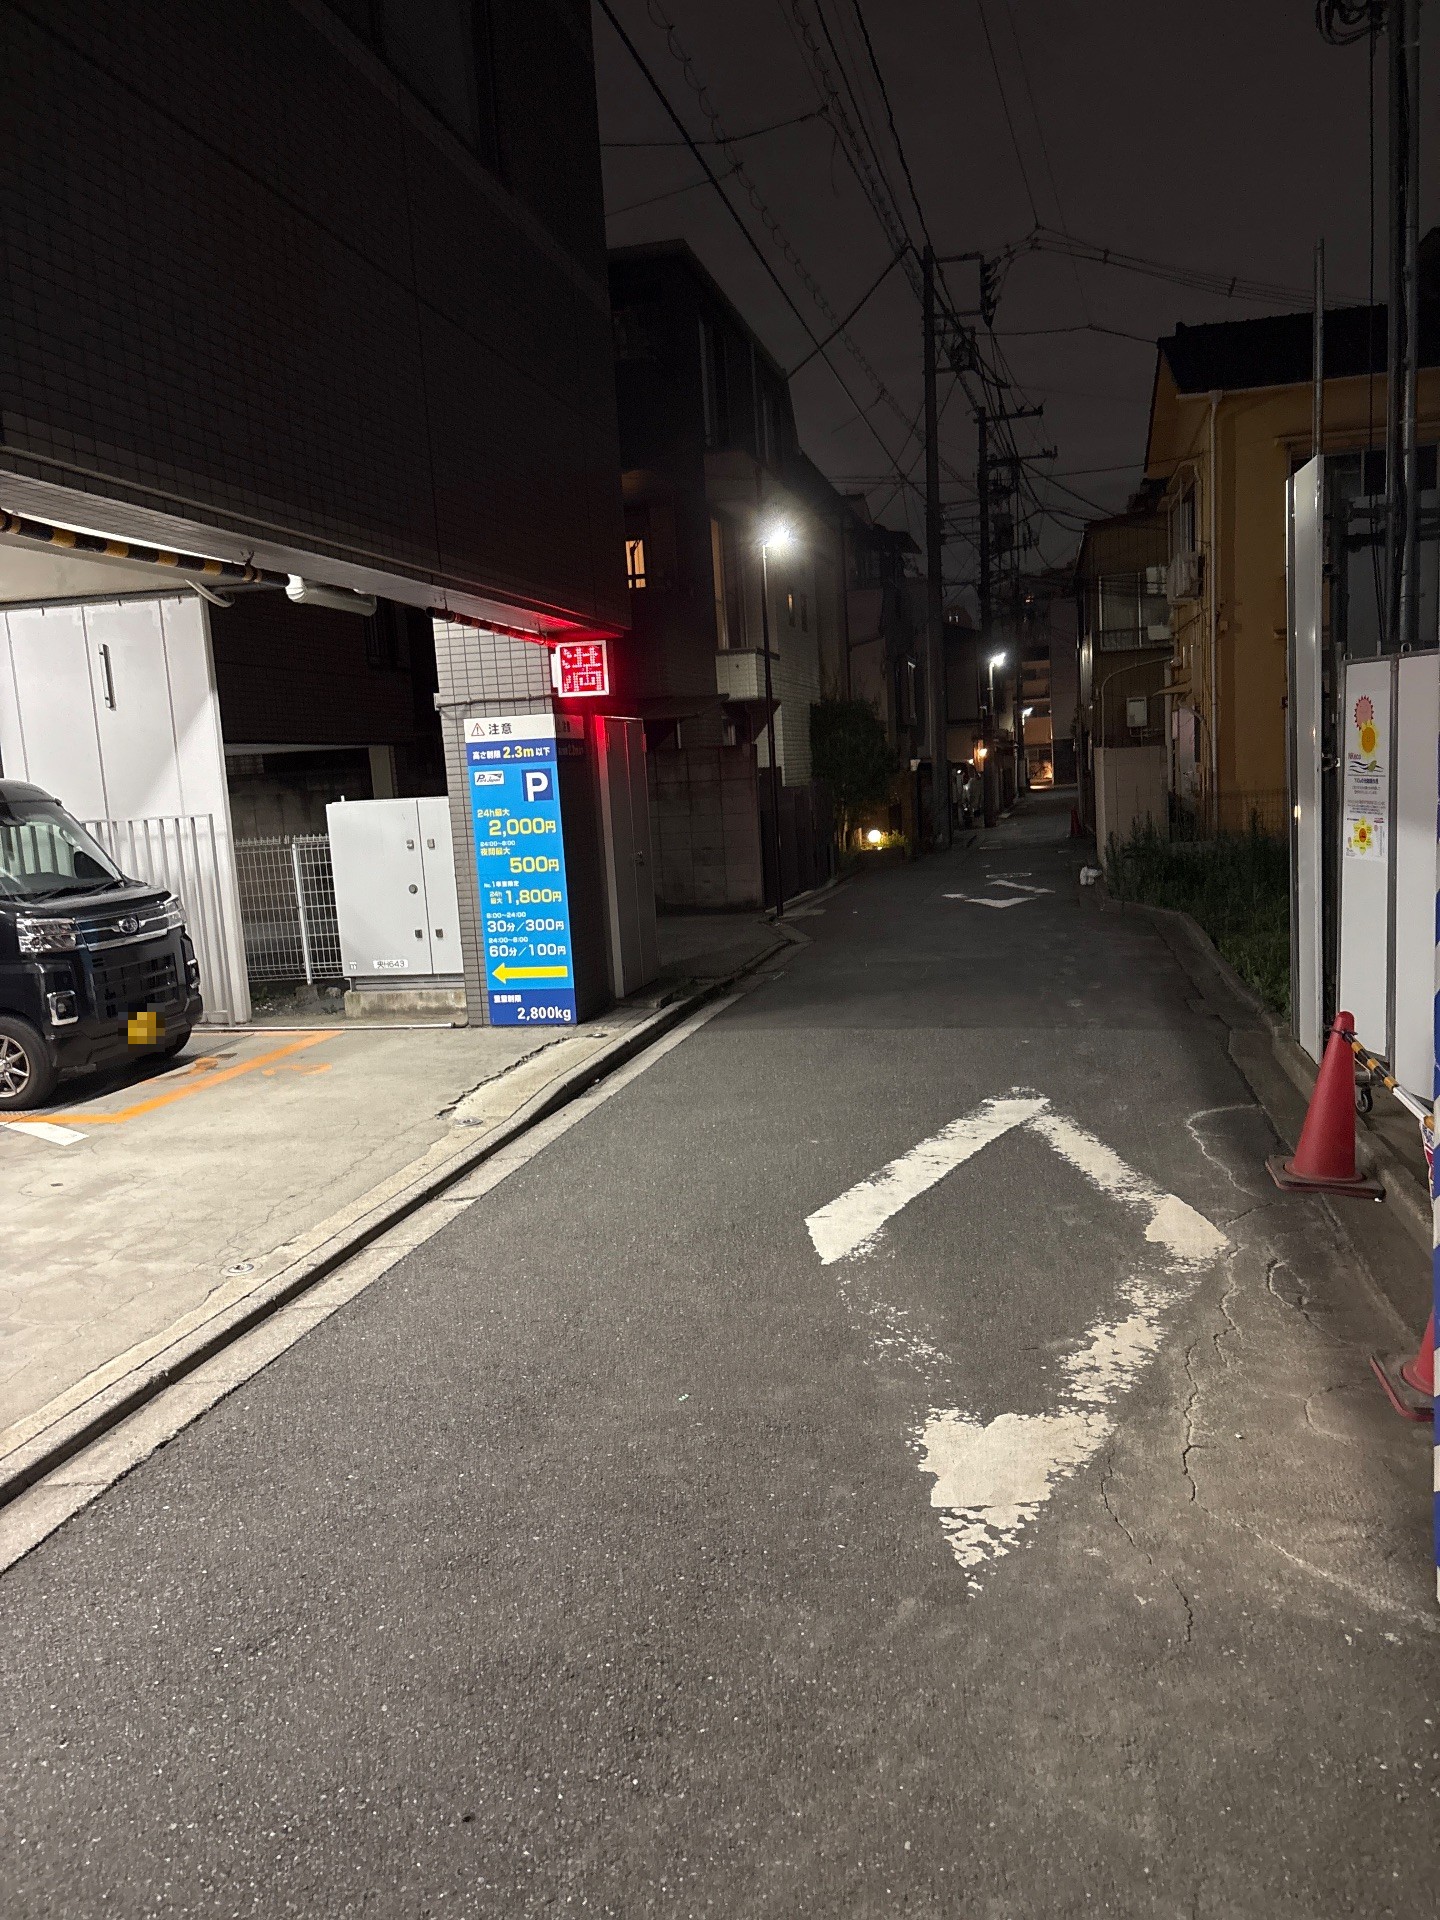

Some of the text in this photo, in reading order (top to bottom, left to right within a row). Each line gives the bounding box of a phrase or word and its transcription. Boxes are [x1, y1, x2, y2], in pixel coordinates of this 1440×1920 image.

[562, 647, 603, 692] 満
[488, 722, 513, 735] 注意
[525, 771, 549, 802] P
[477, 808, 510, 818] 24h最大
[488, 817, 557, 837] 2,000円
[480, 847, 511, 857] 夜間最大
[509, 855, 560, 874] 500円
[490, 897, 503, 905] 最大
[505, 888, 562, 906] 1,800円
[517, 1006, 572, 1022] 2,800kg
